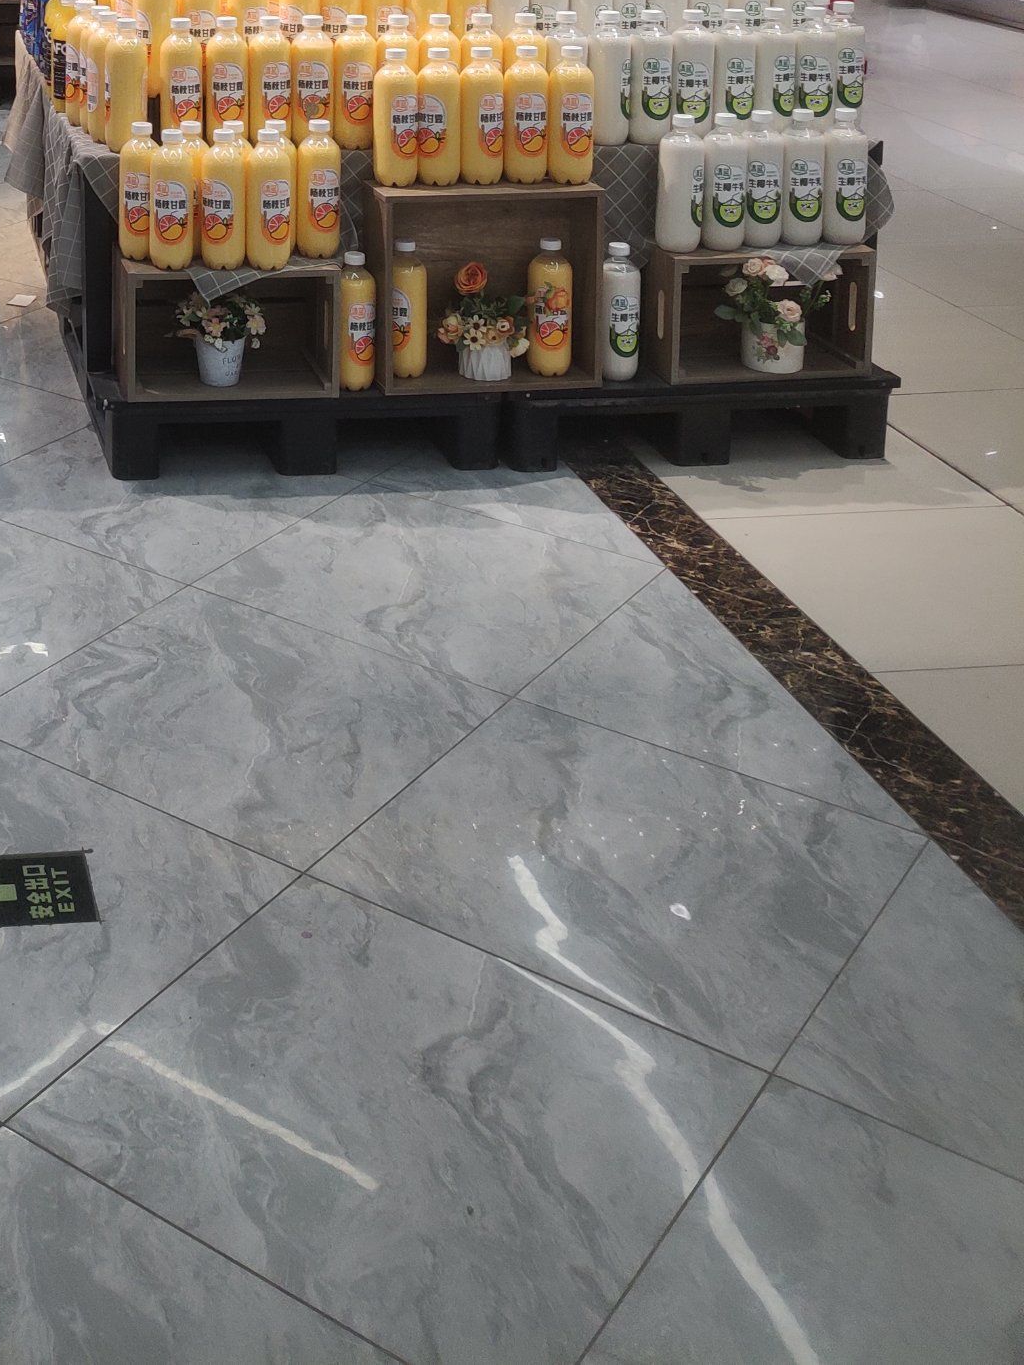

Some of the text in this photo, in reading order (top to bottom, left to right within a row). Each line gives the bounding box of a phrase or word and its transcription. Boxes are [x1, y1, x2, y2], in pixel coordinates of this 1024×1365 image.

[800, 72, 832, 82] 生椰牛乳
[213, 82, 243, 92] 杨枝甘露
[298, 80, 328, 90] 杨枝甘露
[343, 80, 373, 90] 杨枝甘露
[678, 78, 709, 88] 生椰牛乳
[171, 84, 200, 95] 杨枝甘露
[516, 111, 547, 122] 杨枝甘露
[562, 111, 592, 122] 杨枝甘露
[714, 182, 744, 192] 生椰牛乳
[749, 178, 779, 189] 生椰牛乳
[791, 177, 822, 187] 生椰牛乳
[837, 177, 867, 187] 生椰牛乳
[310, 188, 340, 199] 杨枝甘露
[155, 199, 187, 210] 杨枝甘露
[22, 864, 55, 920] 安全出口
[51, 867, 75, 913] EXIT
